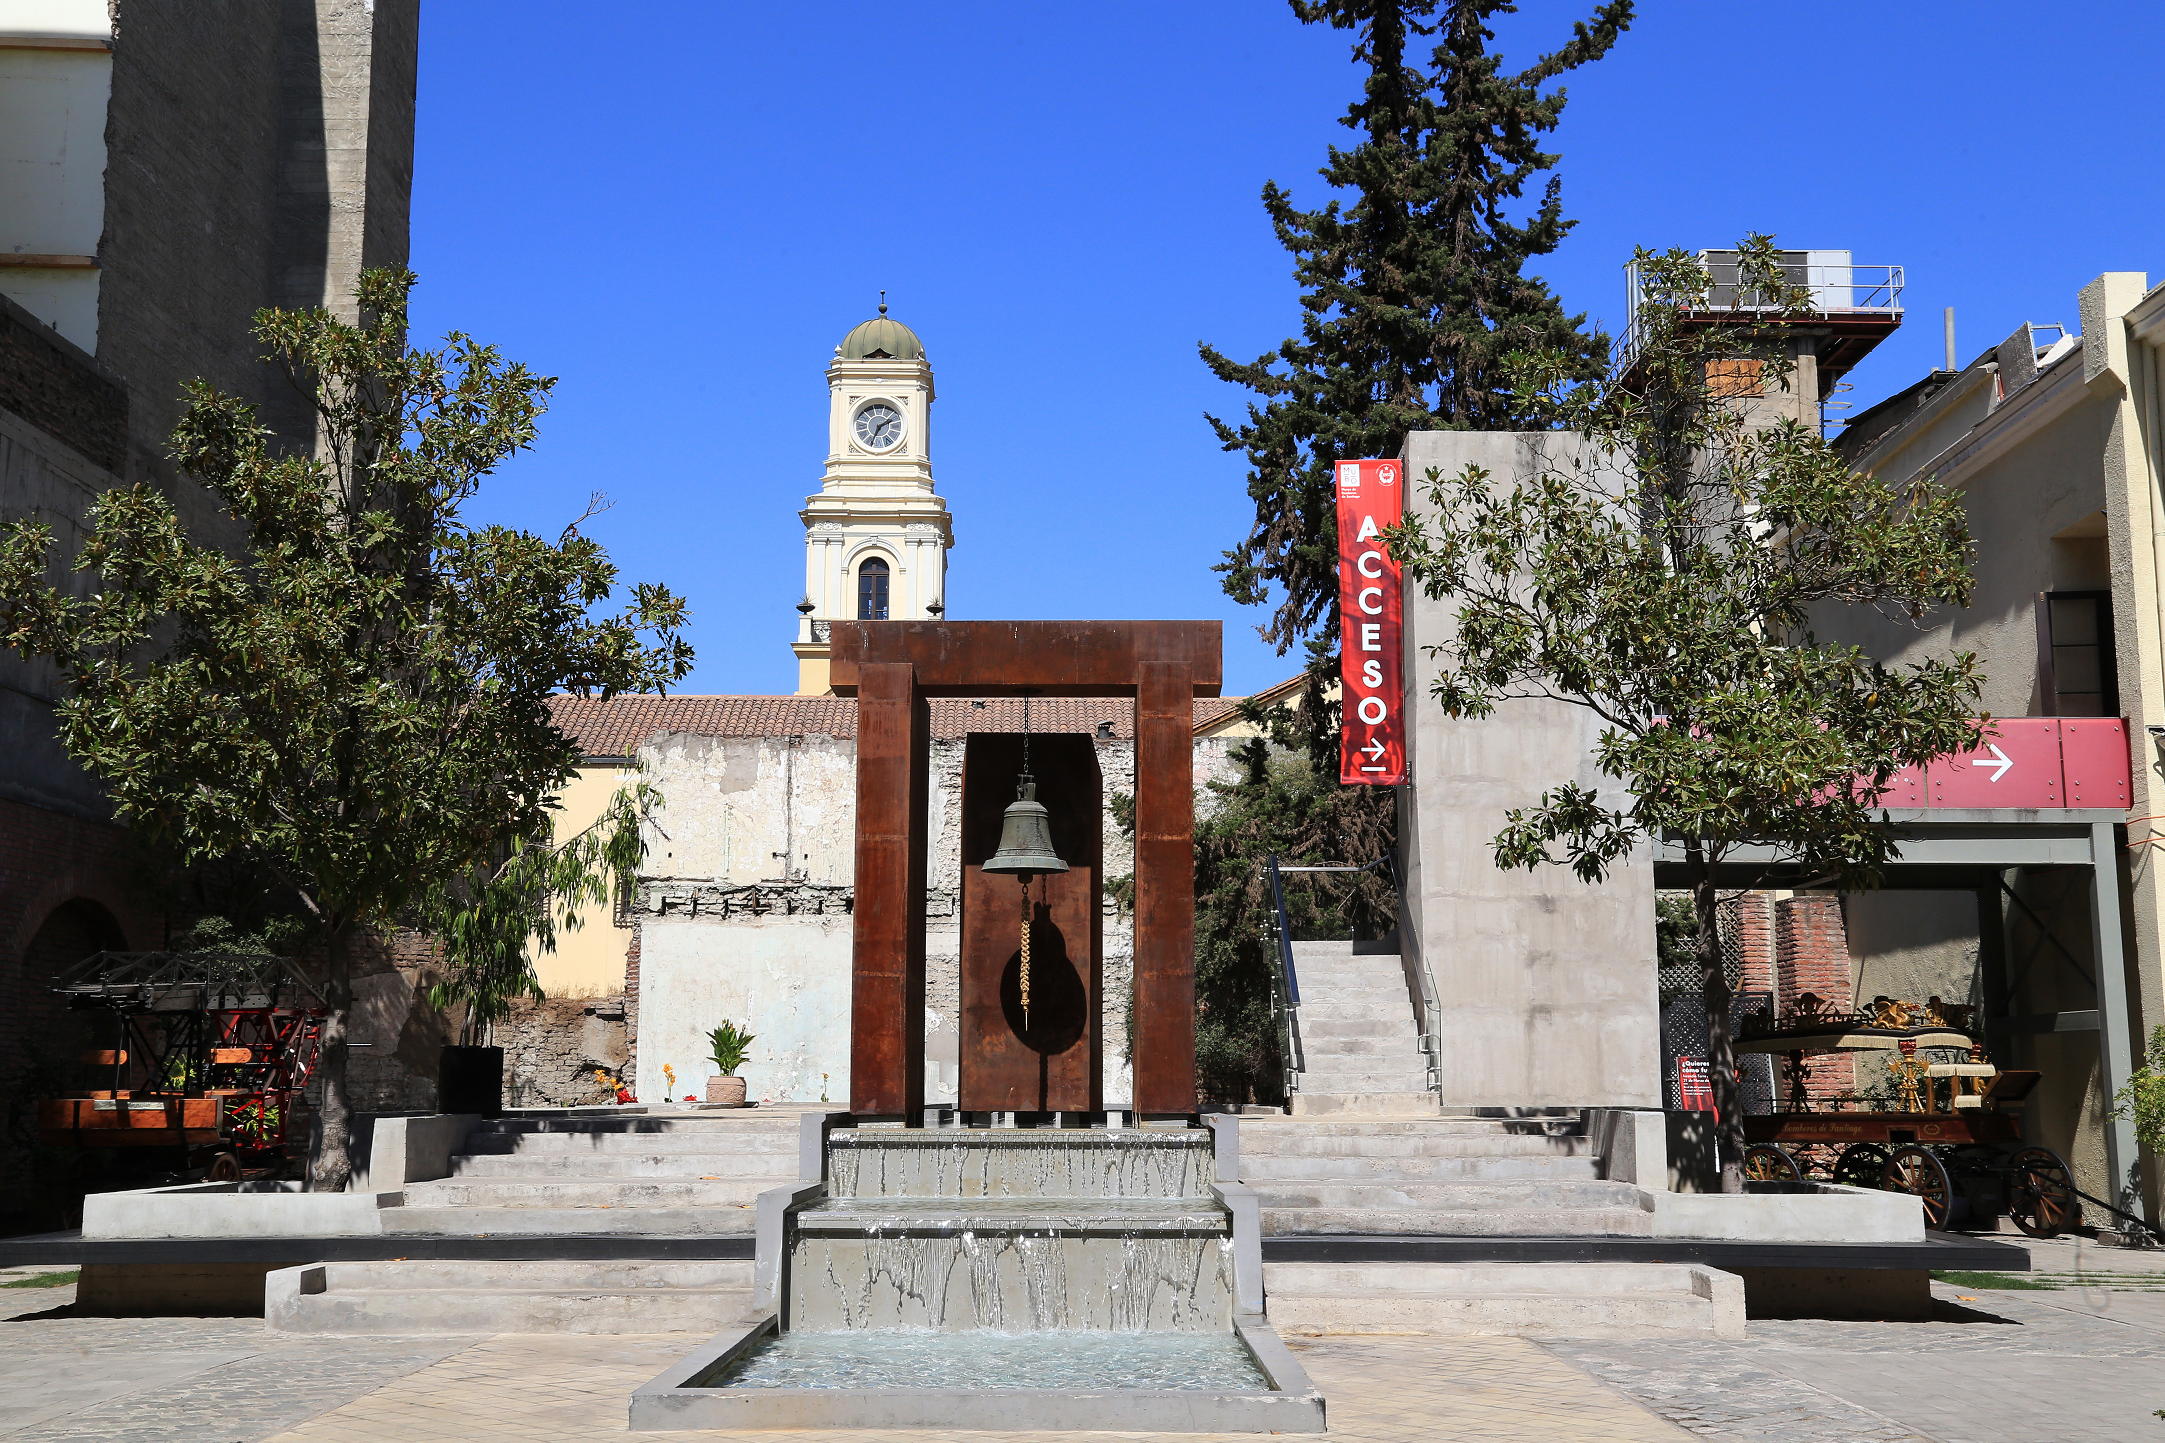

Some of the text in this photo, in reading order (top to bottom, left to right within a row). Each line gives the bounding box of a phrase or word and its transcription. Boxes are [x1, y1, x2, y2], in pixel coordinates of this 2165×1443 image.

[1356, 515, 1388, 725] ACCESO
[1782, 1122, 1862, 1136] Bomberos de Santiago
